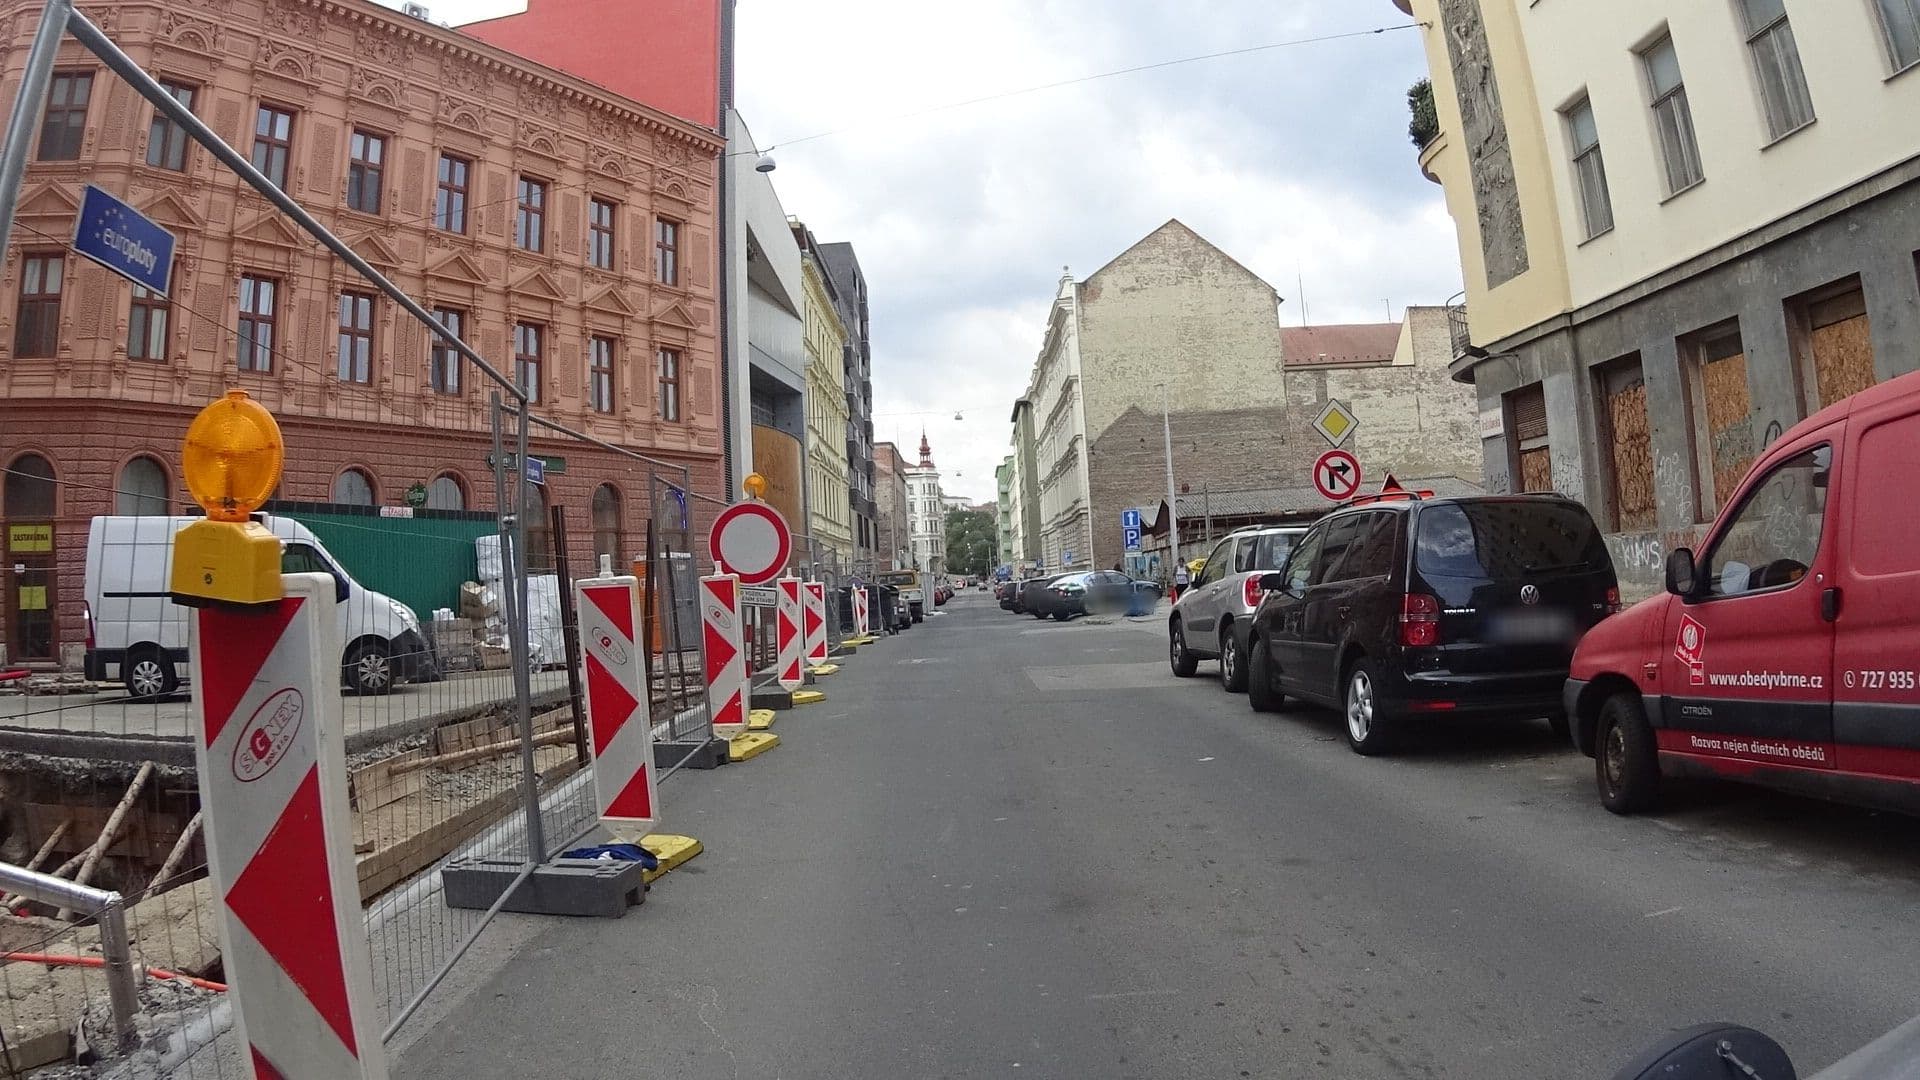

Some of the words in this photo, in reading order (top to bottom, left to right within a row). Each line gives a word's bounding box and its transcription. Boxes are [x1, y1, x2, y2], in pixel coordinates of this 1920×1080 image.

[1709, 670, 1823, 690] www.obedyvbrne.cz
[1860, 670, 1884, 688] 727
[1889, 671, 1915, 689] 935
[240, 694, 300, 774] SIGNEX
[1690, 735, 1721, 749] Rozvoz
[1723, 739, 1749, 754] nejen
[1751, 741, 1790, 758] dietních
[1792, 746, 1826, 762] obědů
